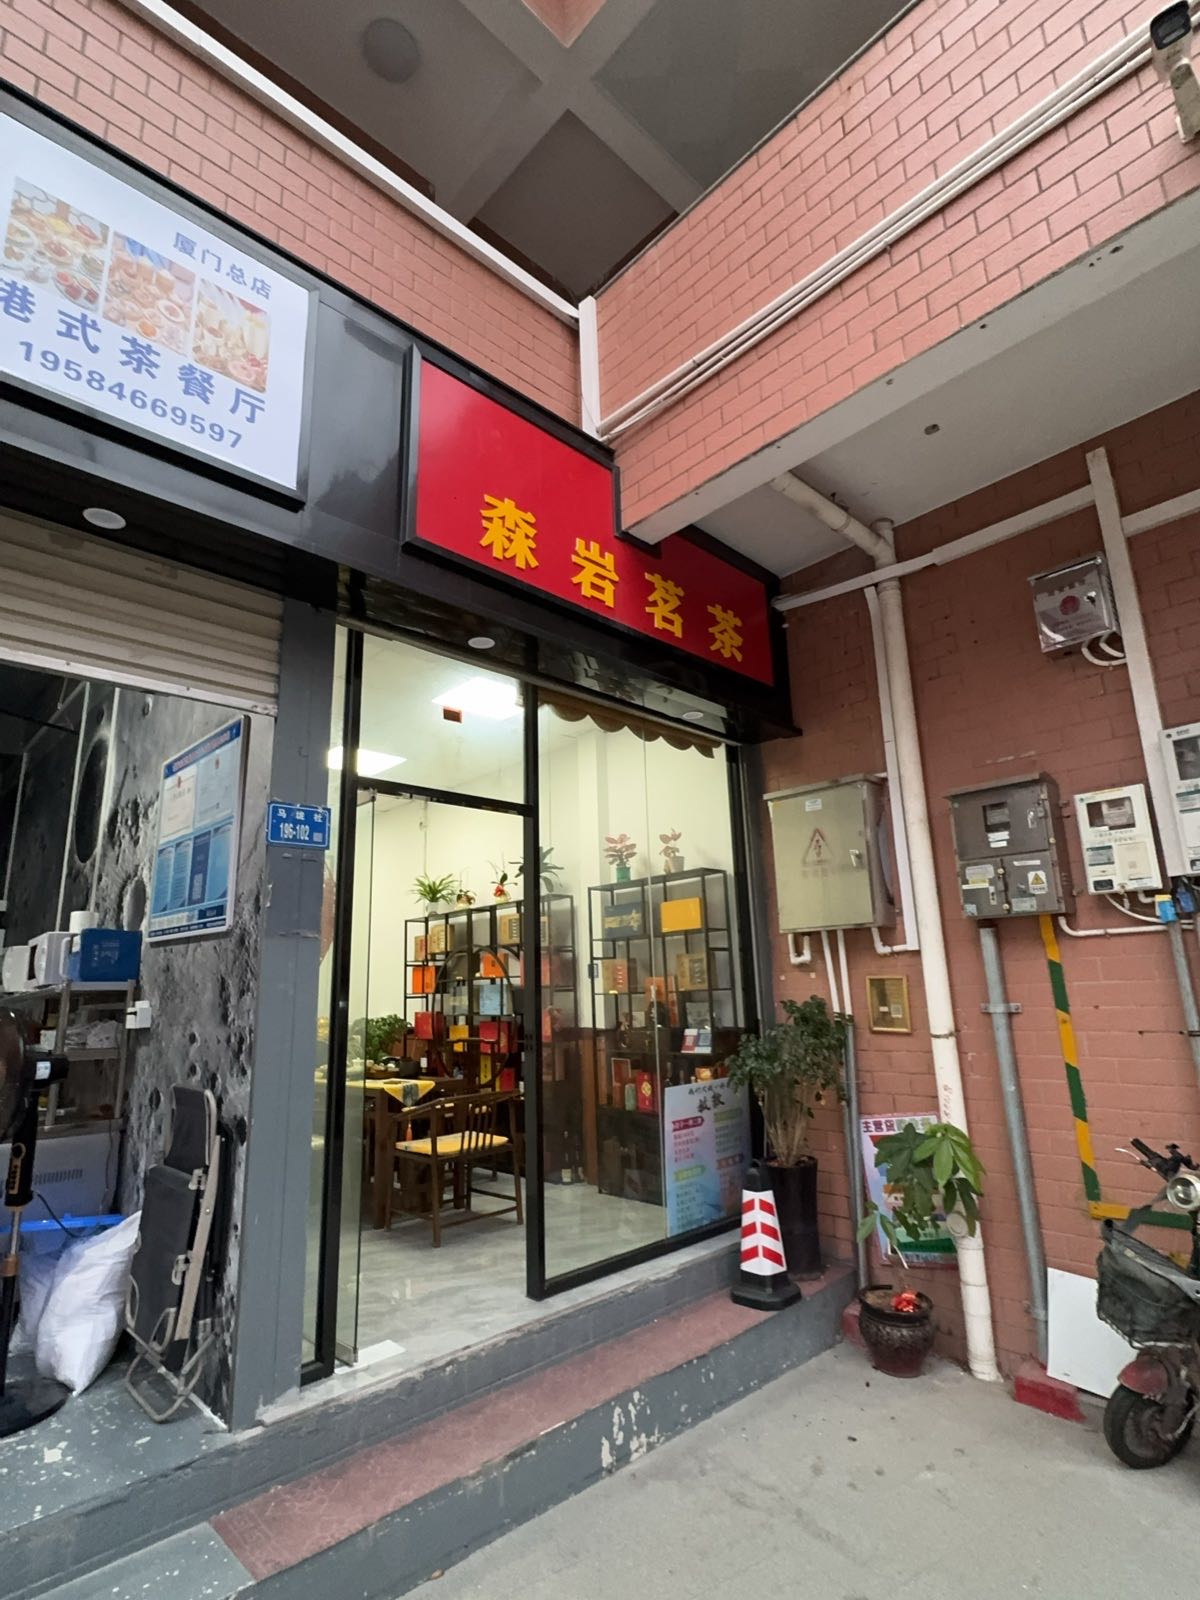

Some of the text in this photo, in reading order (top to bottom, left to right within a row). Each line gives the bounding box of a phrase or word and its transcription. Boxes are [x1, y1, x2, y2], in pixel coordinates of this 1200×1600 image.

[173, 231, 272, 299] 厦门总店
[19, 340, 243, 449] 19584669597
[480, 494, 744, 662] 森岩茗茶
[279, 822, 310, 840] 196-102
